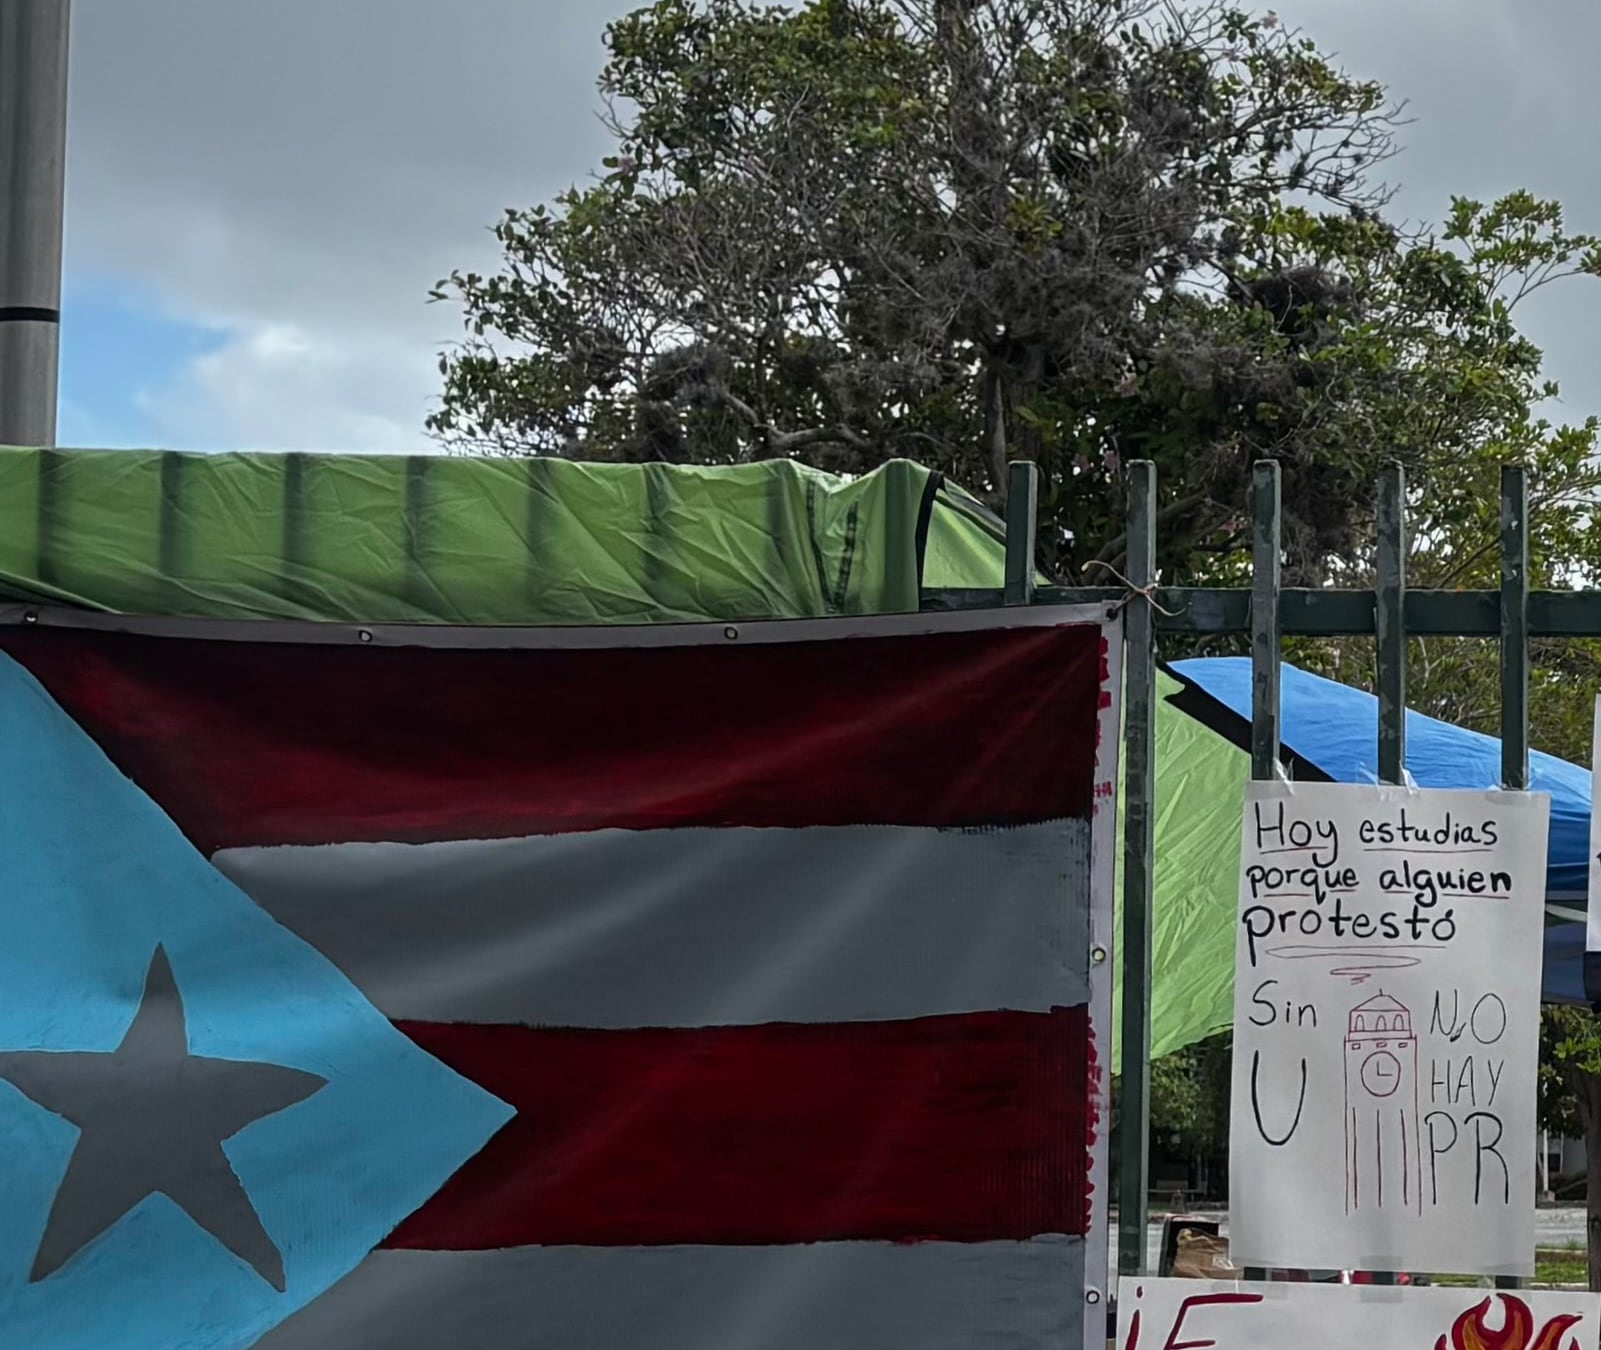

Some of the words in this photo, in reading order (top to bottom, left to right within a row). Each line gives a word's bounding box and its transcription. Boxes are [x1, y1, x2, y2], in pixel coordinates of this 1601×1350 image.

[1255, 802, 1338, 867] Hoy
[1360, 808, 1498, 846] estudias
[1246, 864, 1359, 905] porque
[1380, 860, 1512, 907] alguien
[1242, 899, 1456, 966] protestó
[1248, 980, 1317, 1027] Sin
[1252, 1050, 1306, 1146] U
[1431, 1056, 1504, 1106] HAY
[1425, 1111, 1508, 1204] PR
